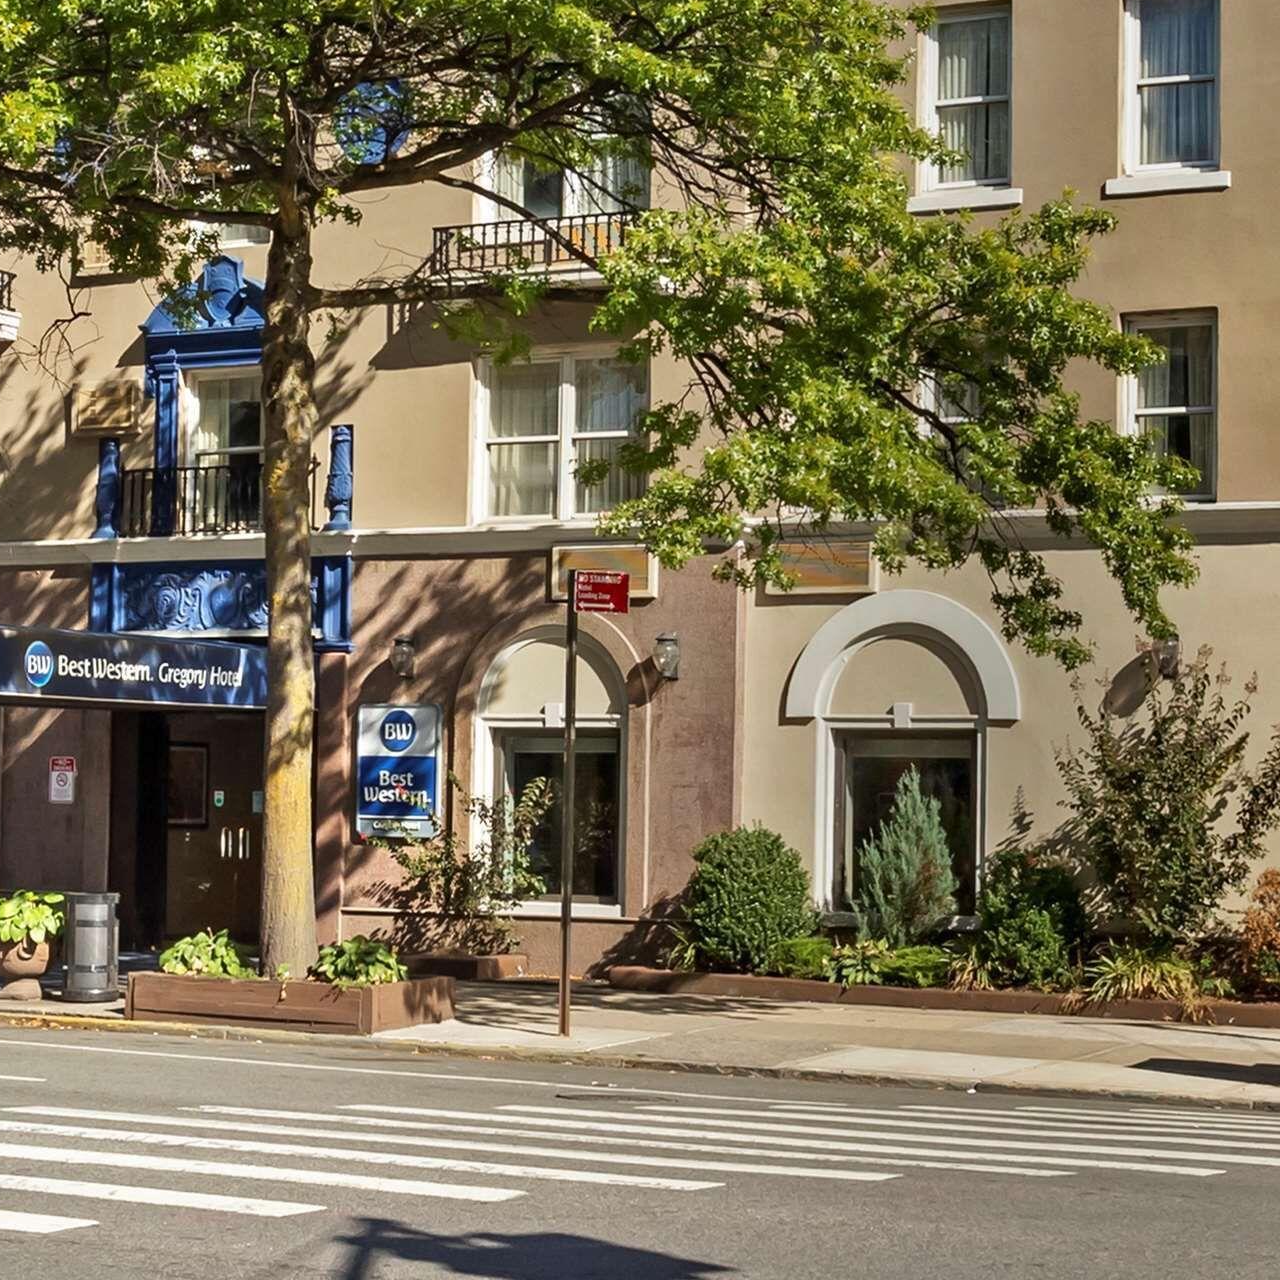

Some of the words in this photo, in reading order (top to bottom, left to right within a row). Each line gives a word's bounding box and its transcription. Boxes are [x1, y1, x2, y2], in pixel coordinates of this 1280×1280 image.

[578, 573, 589, 583] NO
[27, 654, 51, 674] BW
[58, 654, 91, 677] Best
[158, 662, 207, 689] Gregory
[210, 665, 242, 687] Hotel
[384, 723, 412, 740] BW
[379, 770, 414, 786] Best
